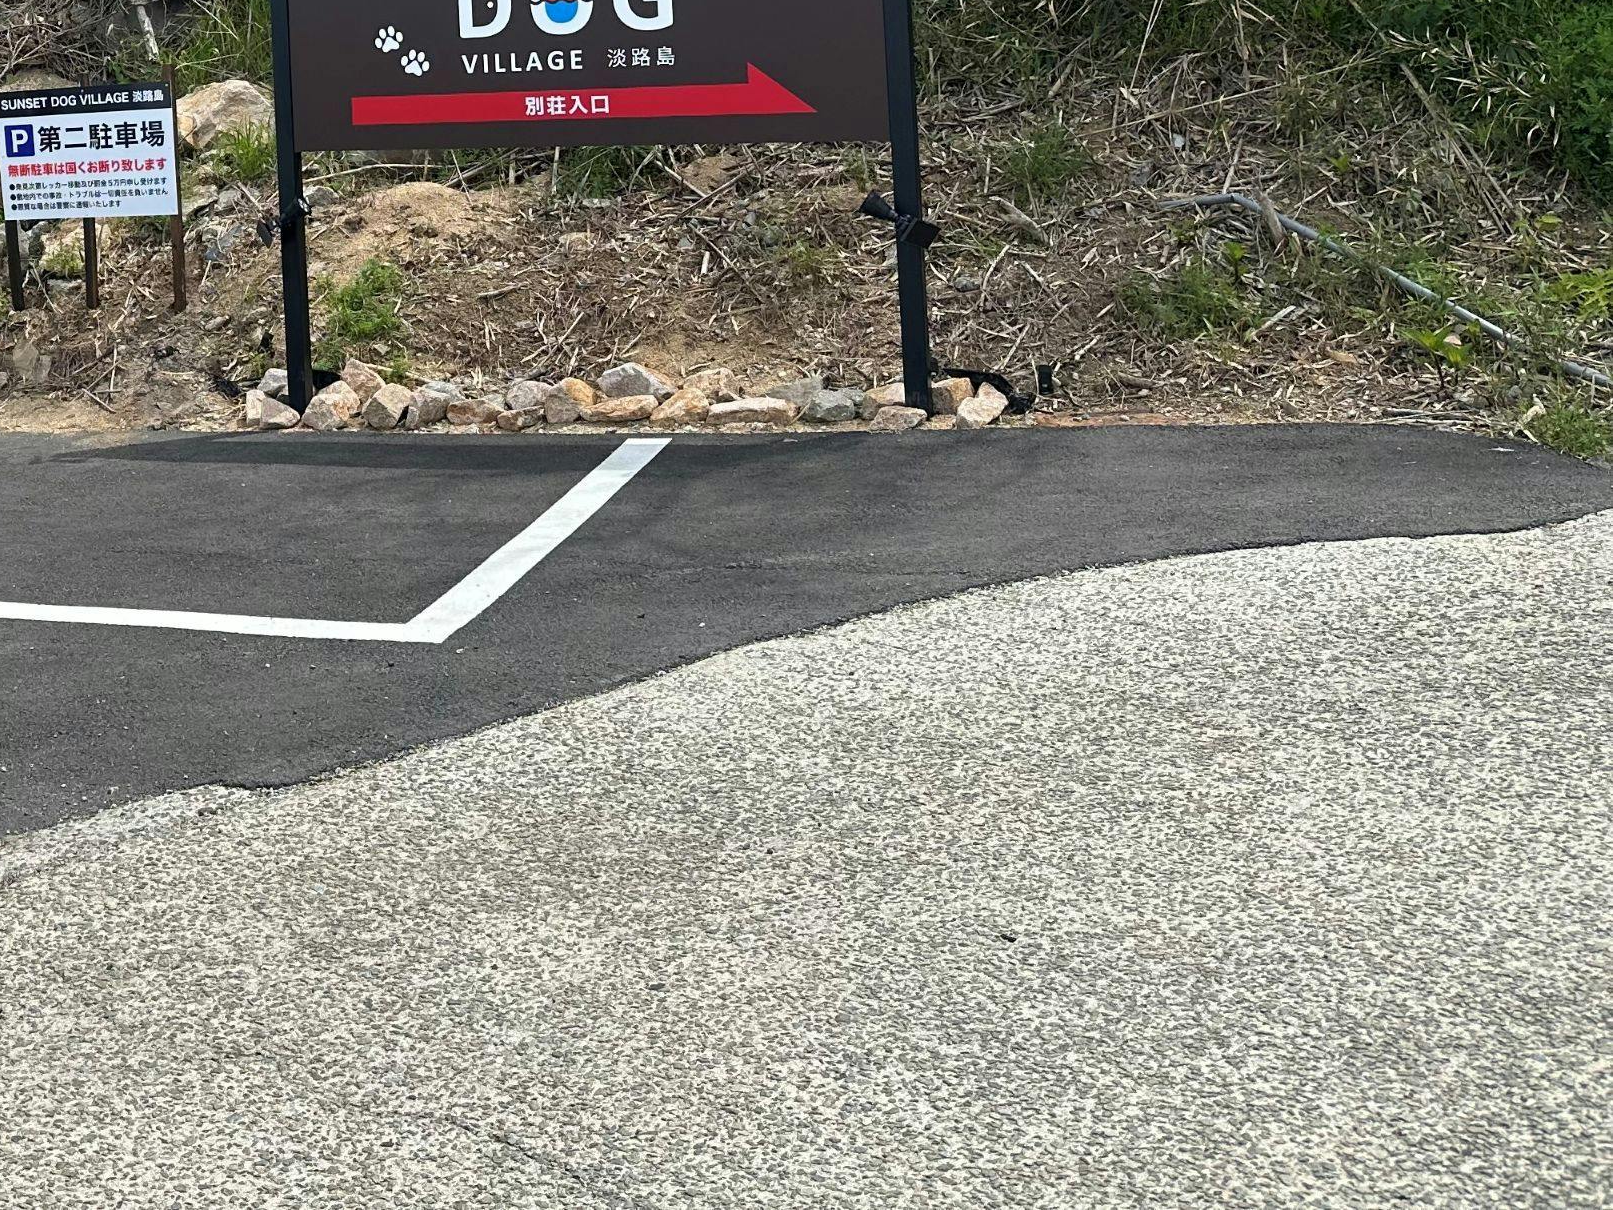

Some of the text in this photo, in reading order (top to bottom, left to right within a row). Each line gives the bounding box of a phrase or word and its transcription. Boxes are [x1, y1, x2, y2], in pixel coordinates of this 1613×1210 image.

[461, 45, 676, 75] VILLAGE 淡路島
[1, 89, 164, 111] SUNSET DOG VILLAGE 淡路島
[524, 94, 611, 117] 別荘入口
[11, 120, 165, 153] P 第二駐車場
[8, 157, 167, 177] 無断駐車は固くお断り致します
